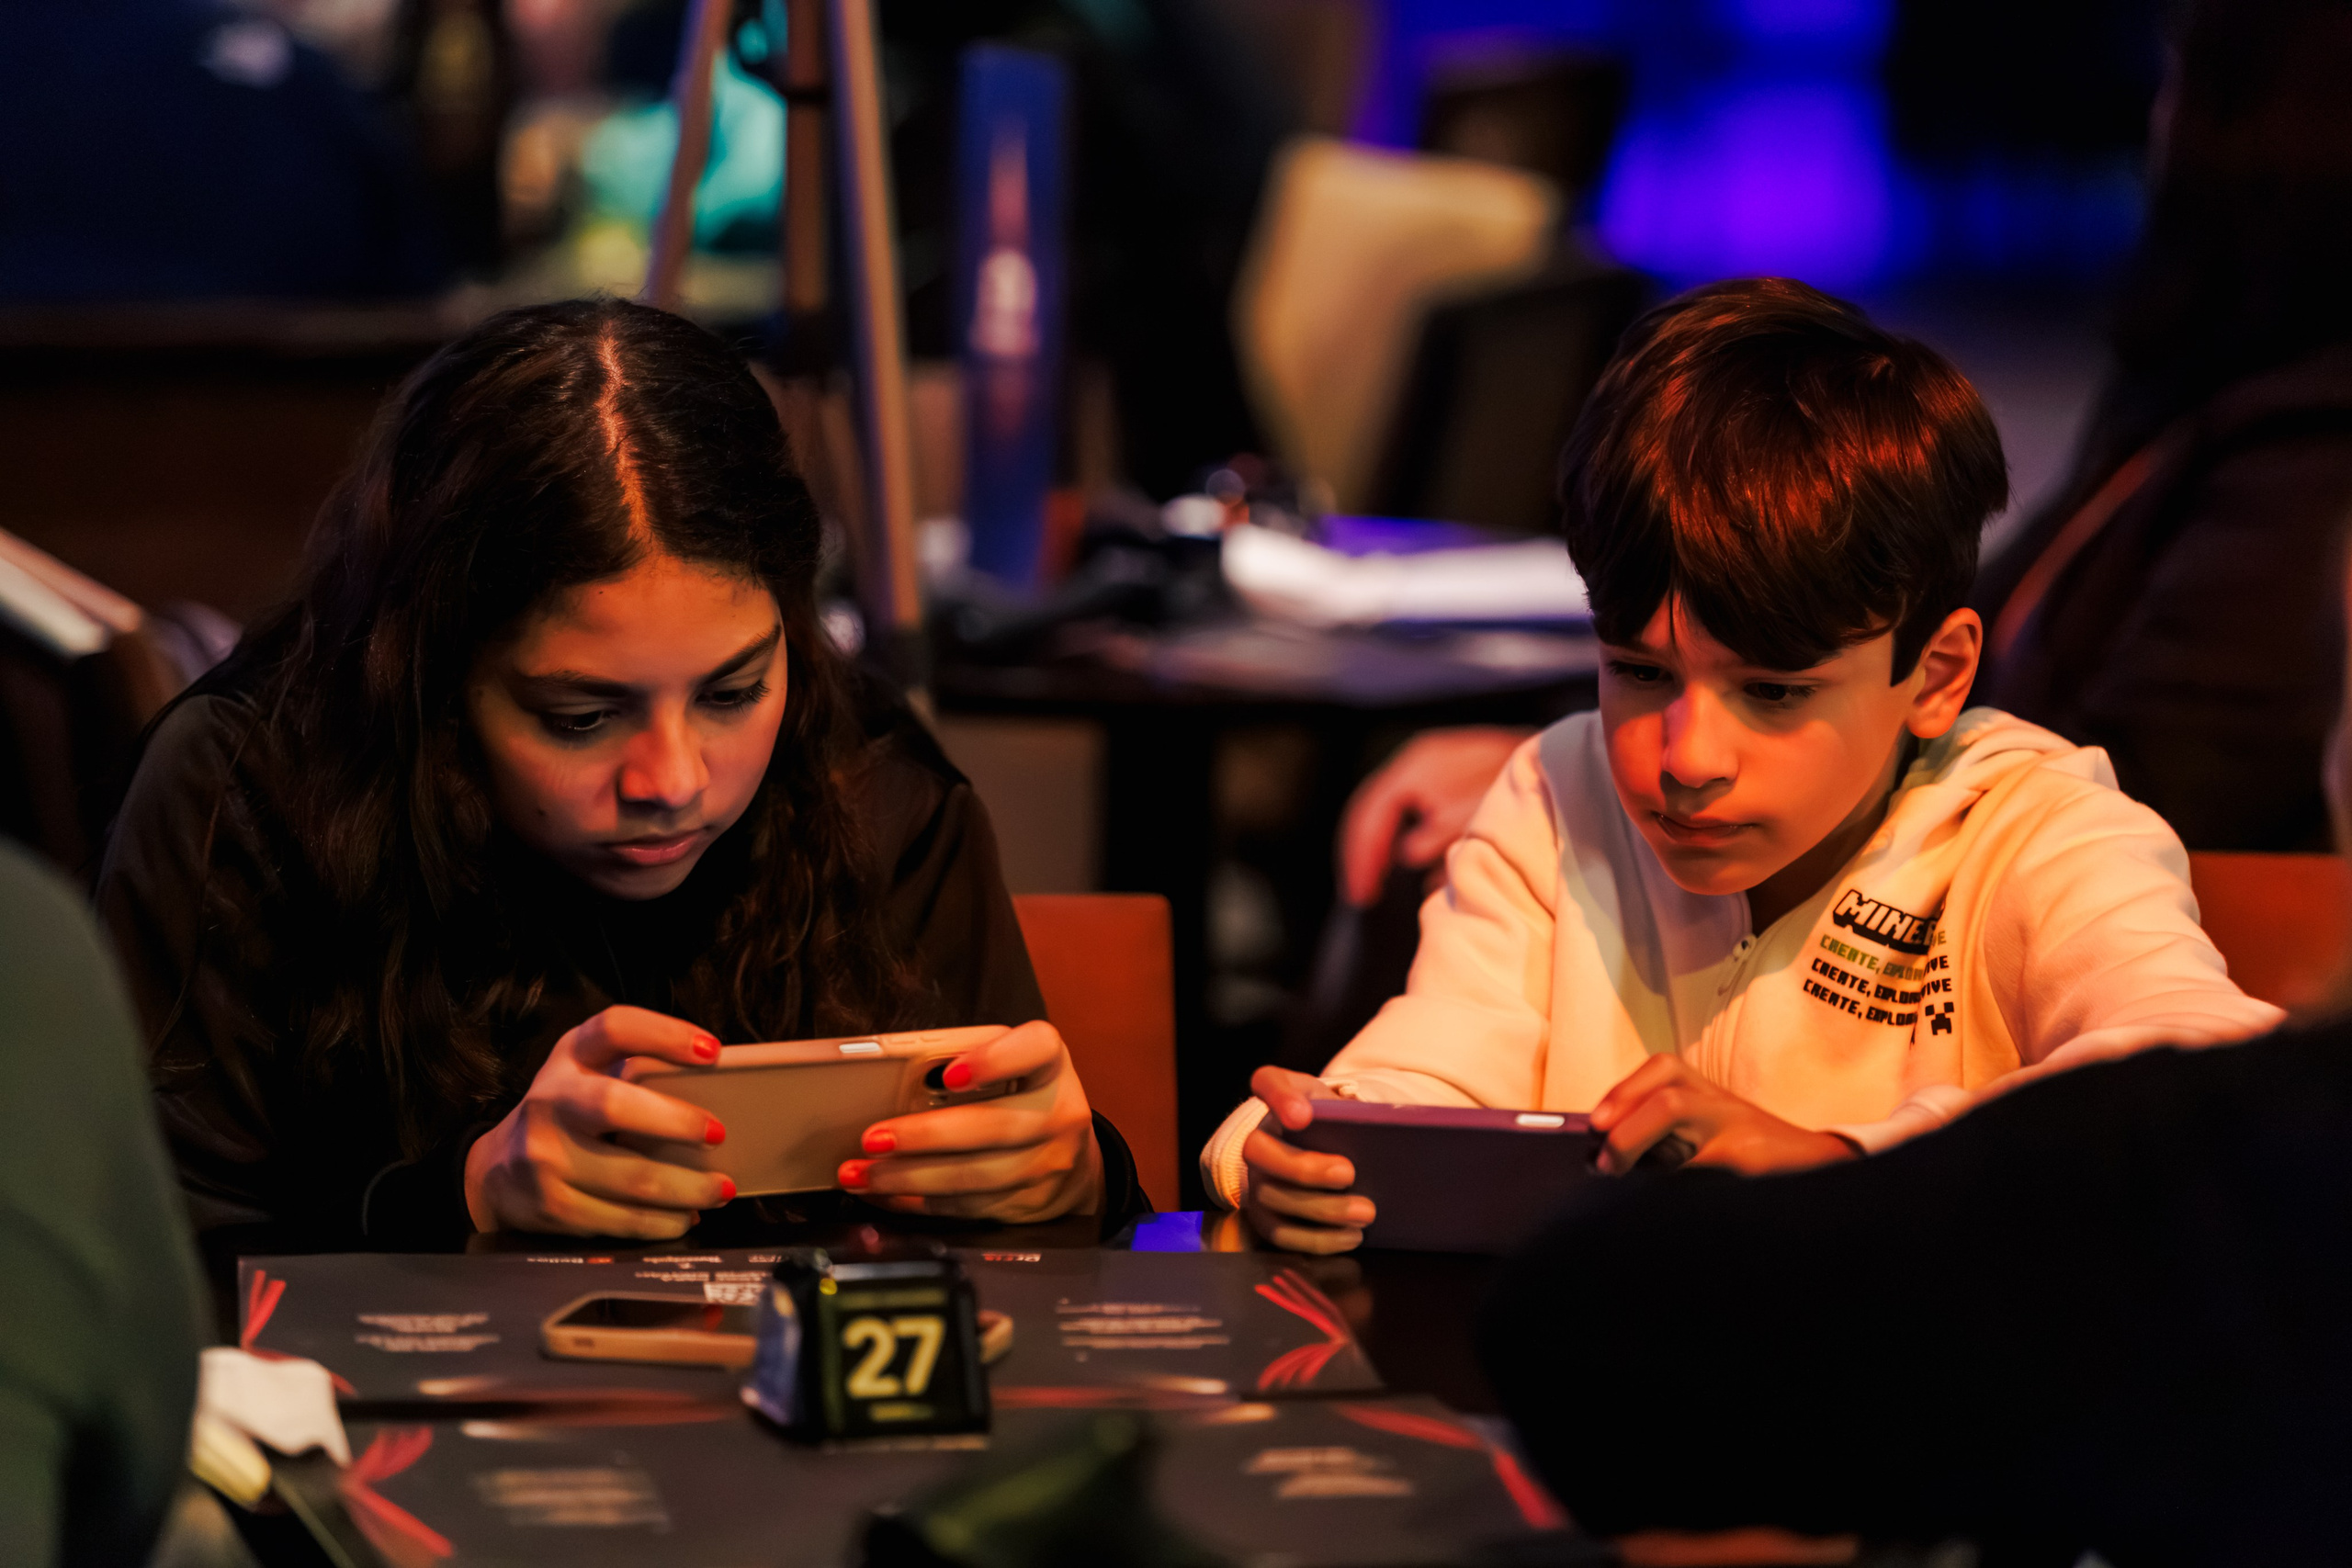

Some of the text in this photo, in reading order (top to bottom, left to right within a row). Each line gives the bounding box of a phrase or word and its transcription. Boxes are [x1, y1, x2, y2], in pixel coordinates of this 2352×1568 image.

[1811, 958, 1871, 997] CREATE,
[1883, 962, 1925, 982] EXPLOR
[1803, 978, 1862, 1019] CREATE,
[842, 1315, 944, 1399] 27
